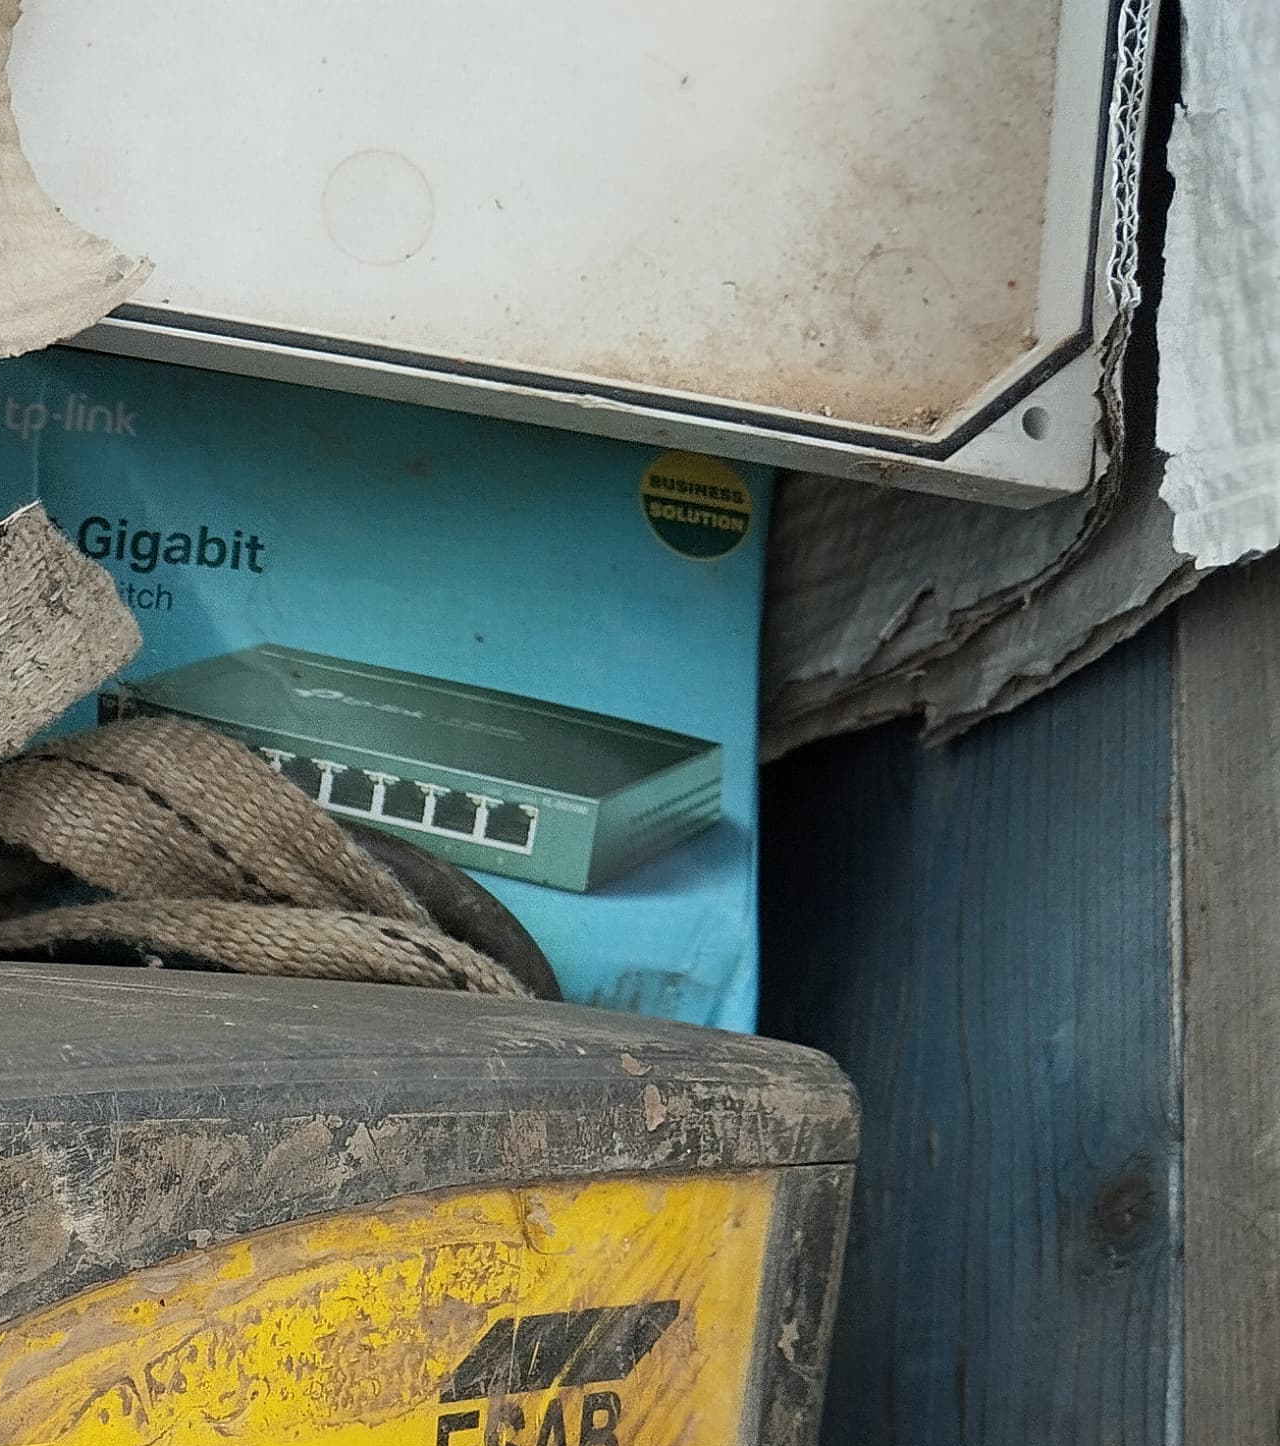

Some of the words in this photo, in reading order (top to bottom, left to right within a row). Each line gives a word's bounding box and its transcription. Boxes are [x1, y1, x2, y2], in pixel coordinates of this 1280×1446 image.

[4, 393, 137, 440] tp-link
[649, 474, 744, 505] BUSINESS
[649, 501, 744, 533] SOLUTION
[76, 515, 266, 574] Gigabit
